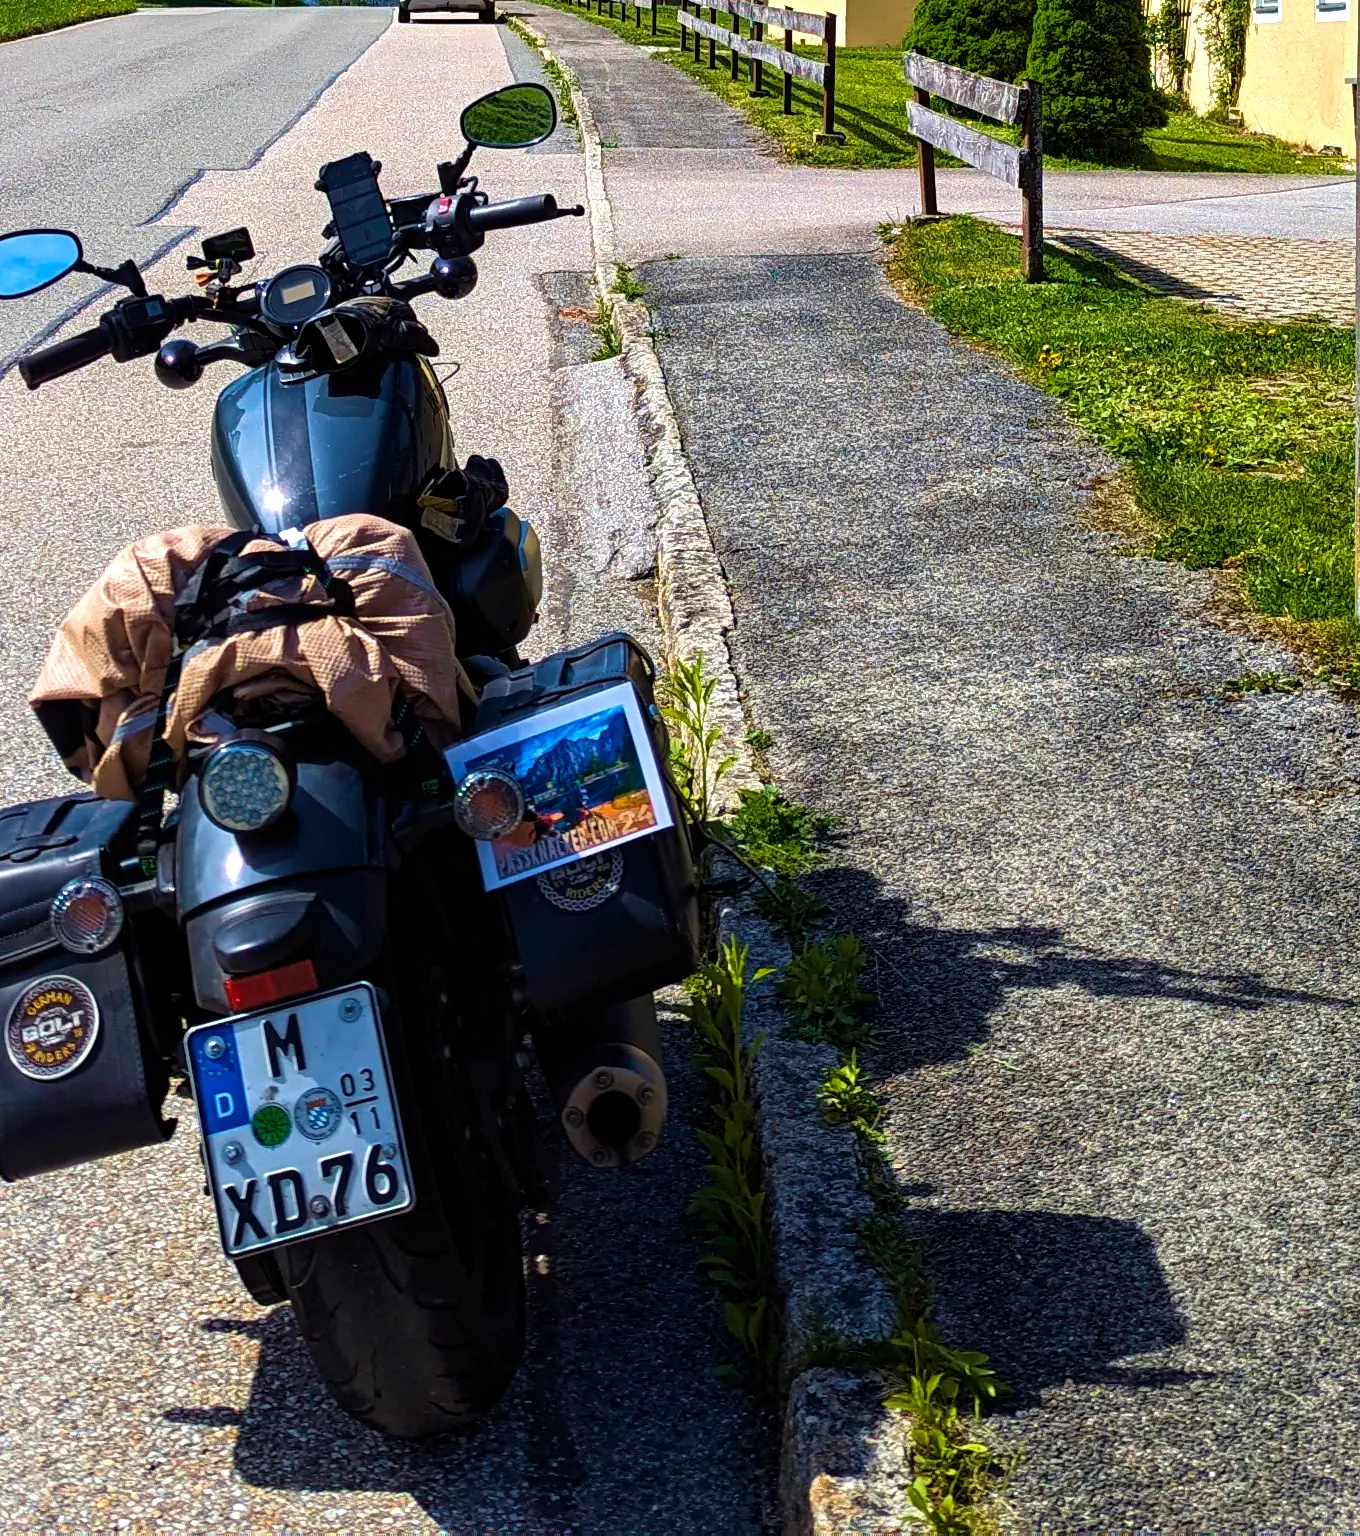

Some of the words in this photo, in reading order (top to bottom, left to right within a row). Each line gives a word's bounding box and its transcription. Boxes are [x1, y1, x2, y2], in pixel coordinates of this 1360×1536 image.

[261, 1013, 307, 1078] M
[214, 1092, 235, 1118] D
[340, 1068, 375, 1096] 03
[318, 1143, 399, 1218] 76
